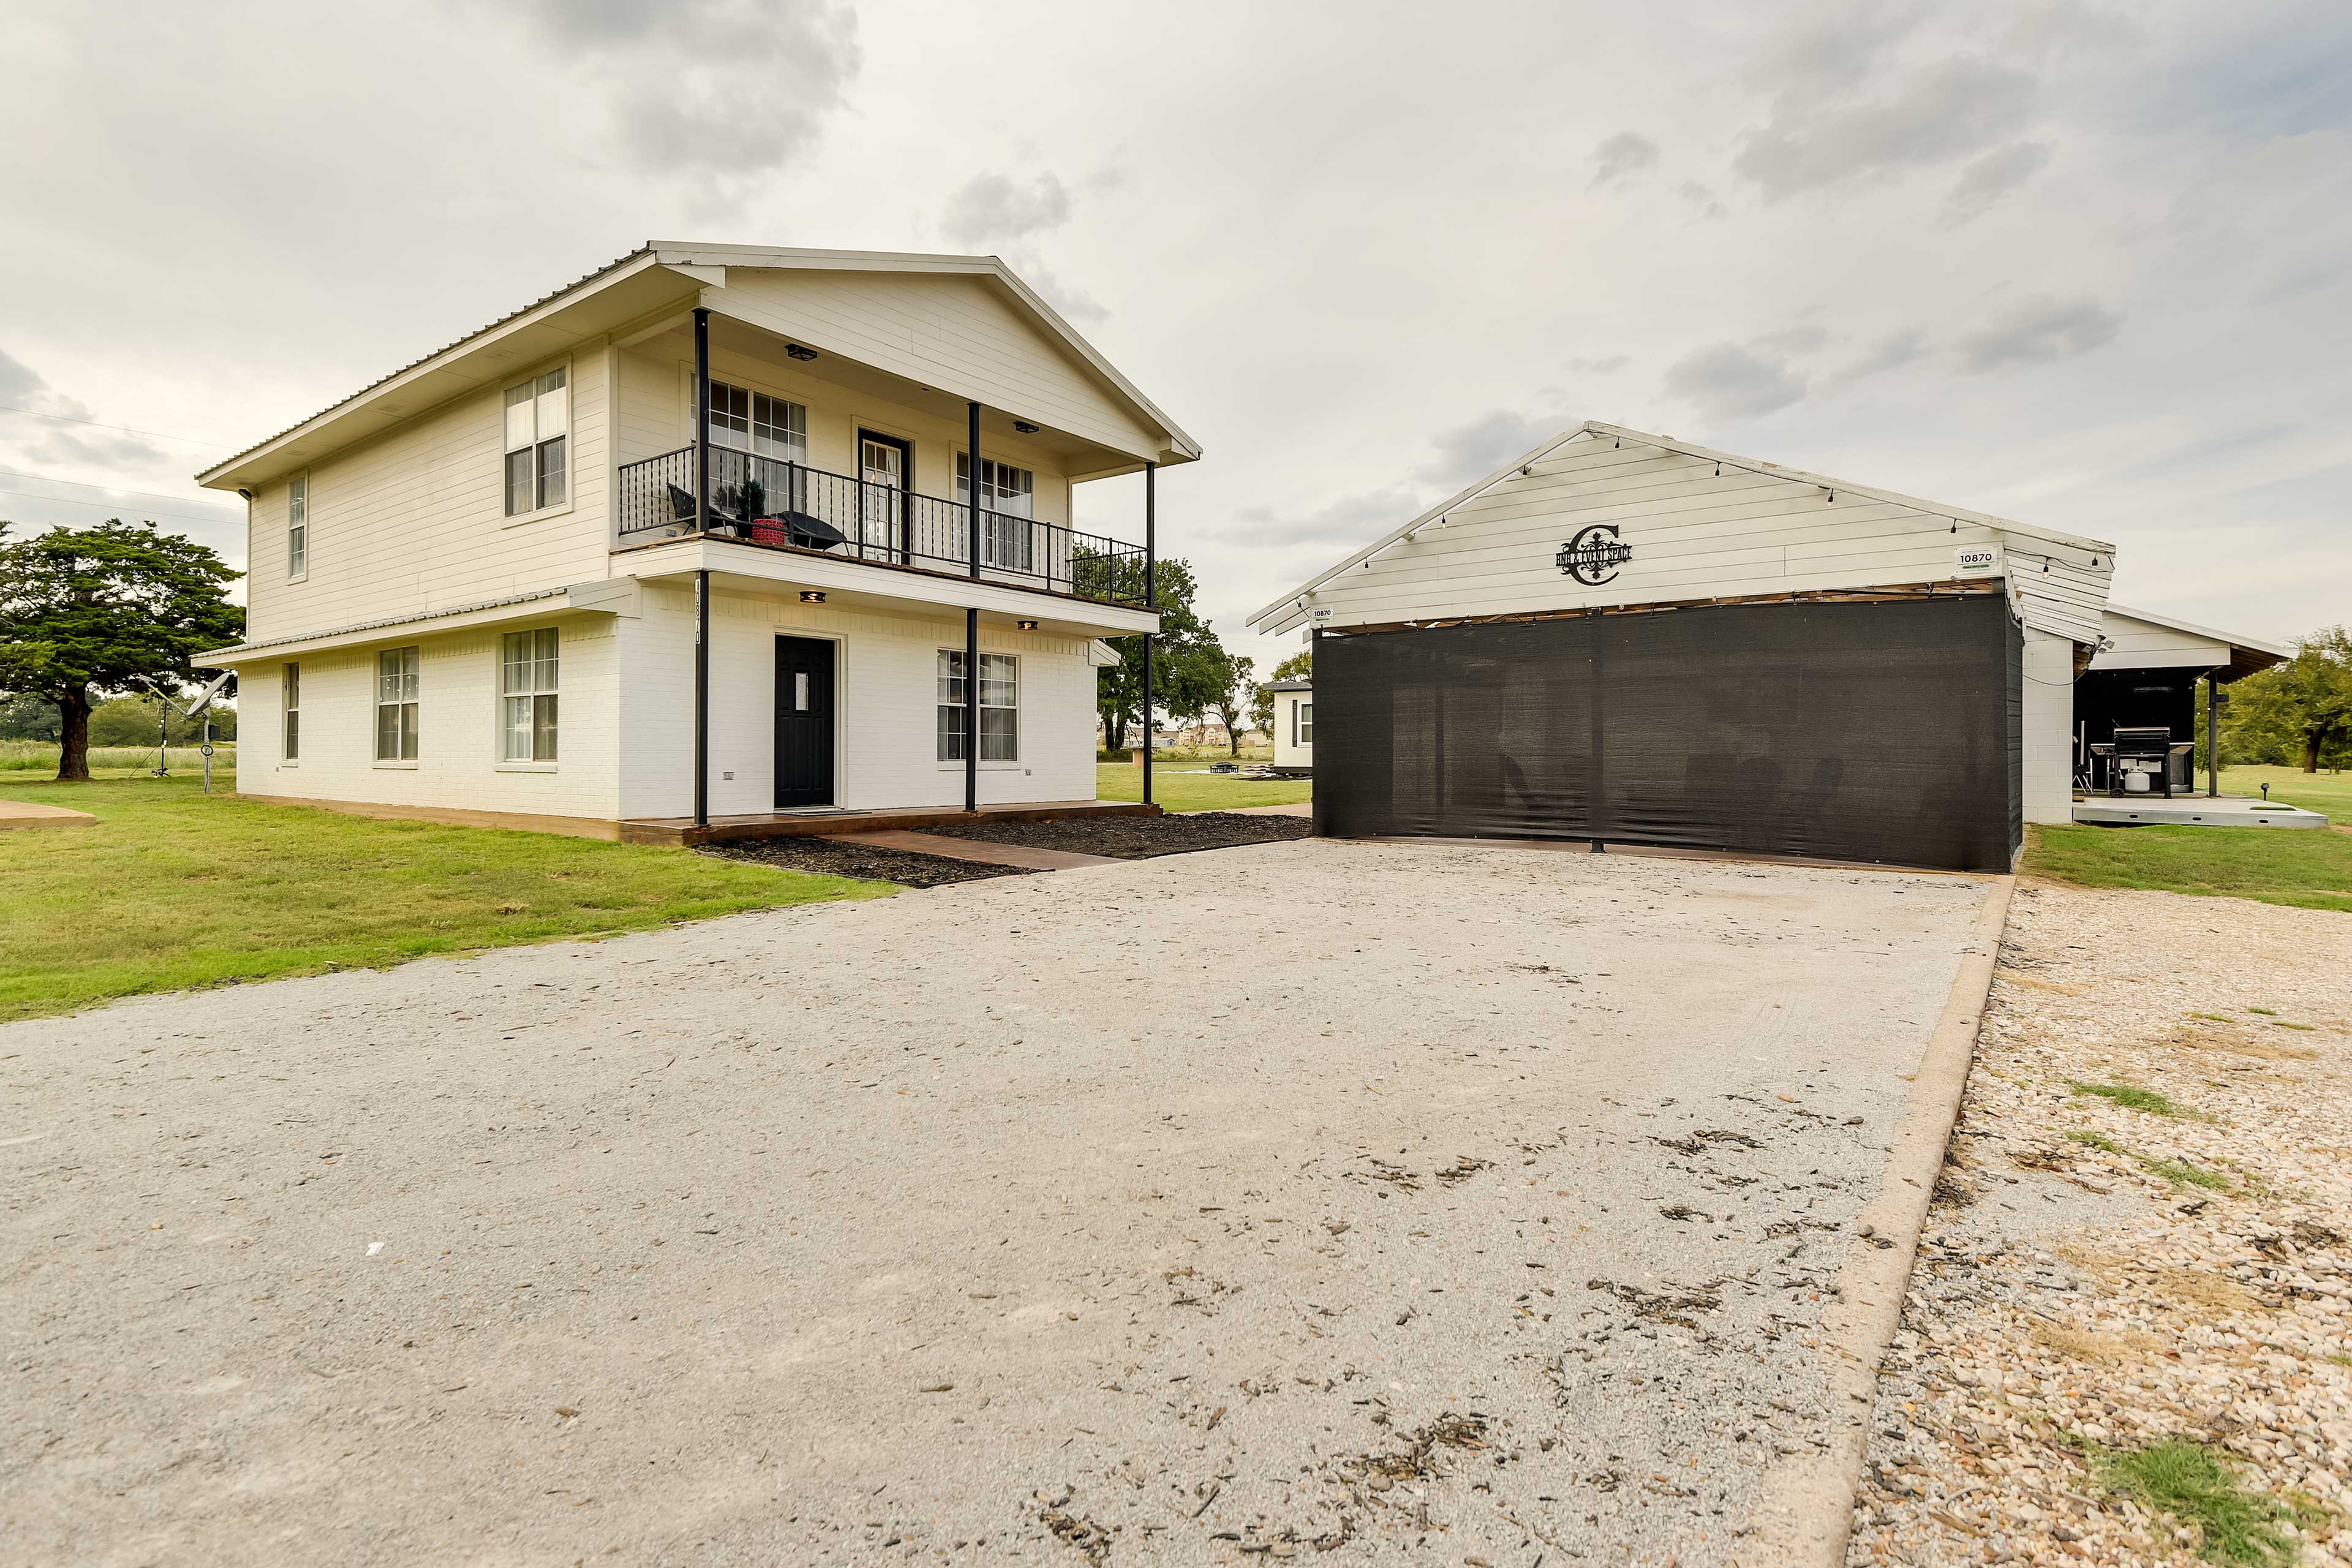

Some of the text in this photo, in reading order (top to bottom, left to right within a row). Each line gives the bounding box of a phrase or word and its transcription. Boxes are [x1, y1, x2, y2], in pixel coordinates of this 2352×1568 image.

[1556, 546, 1632, 565] BNB & EVENT SPACE
[1568, 524, 1619, 586] C
[1960, 553, 1992, 563] 10870
